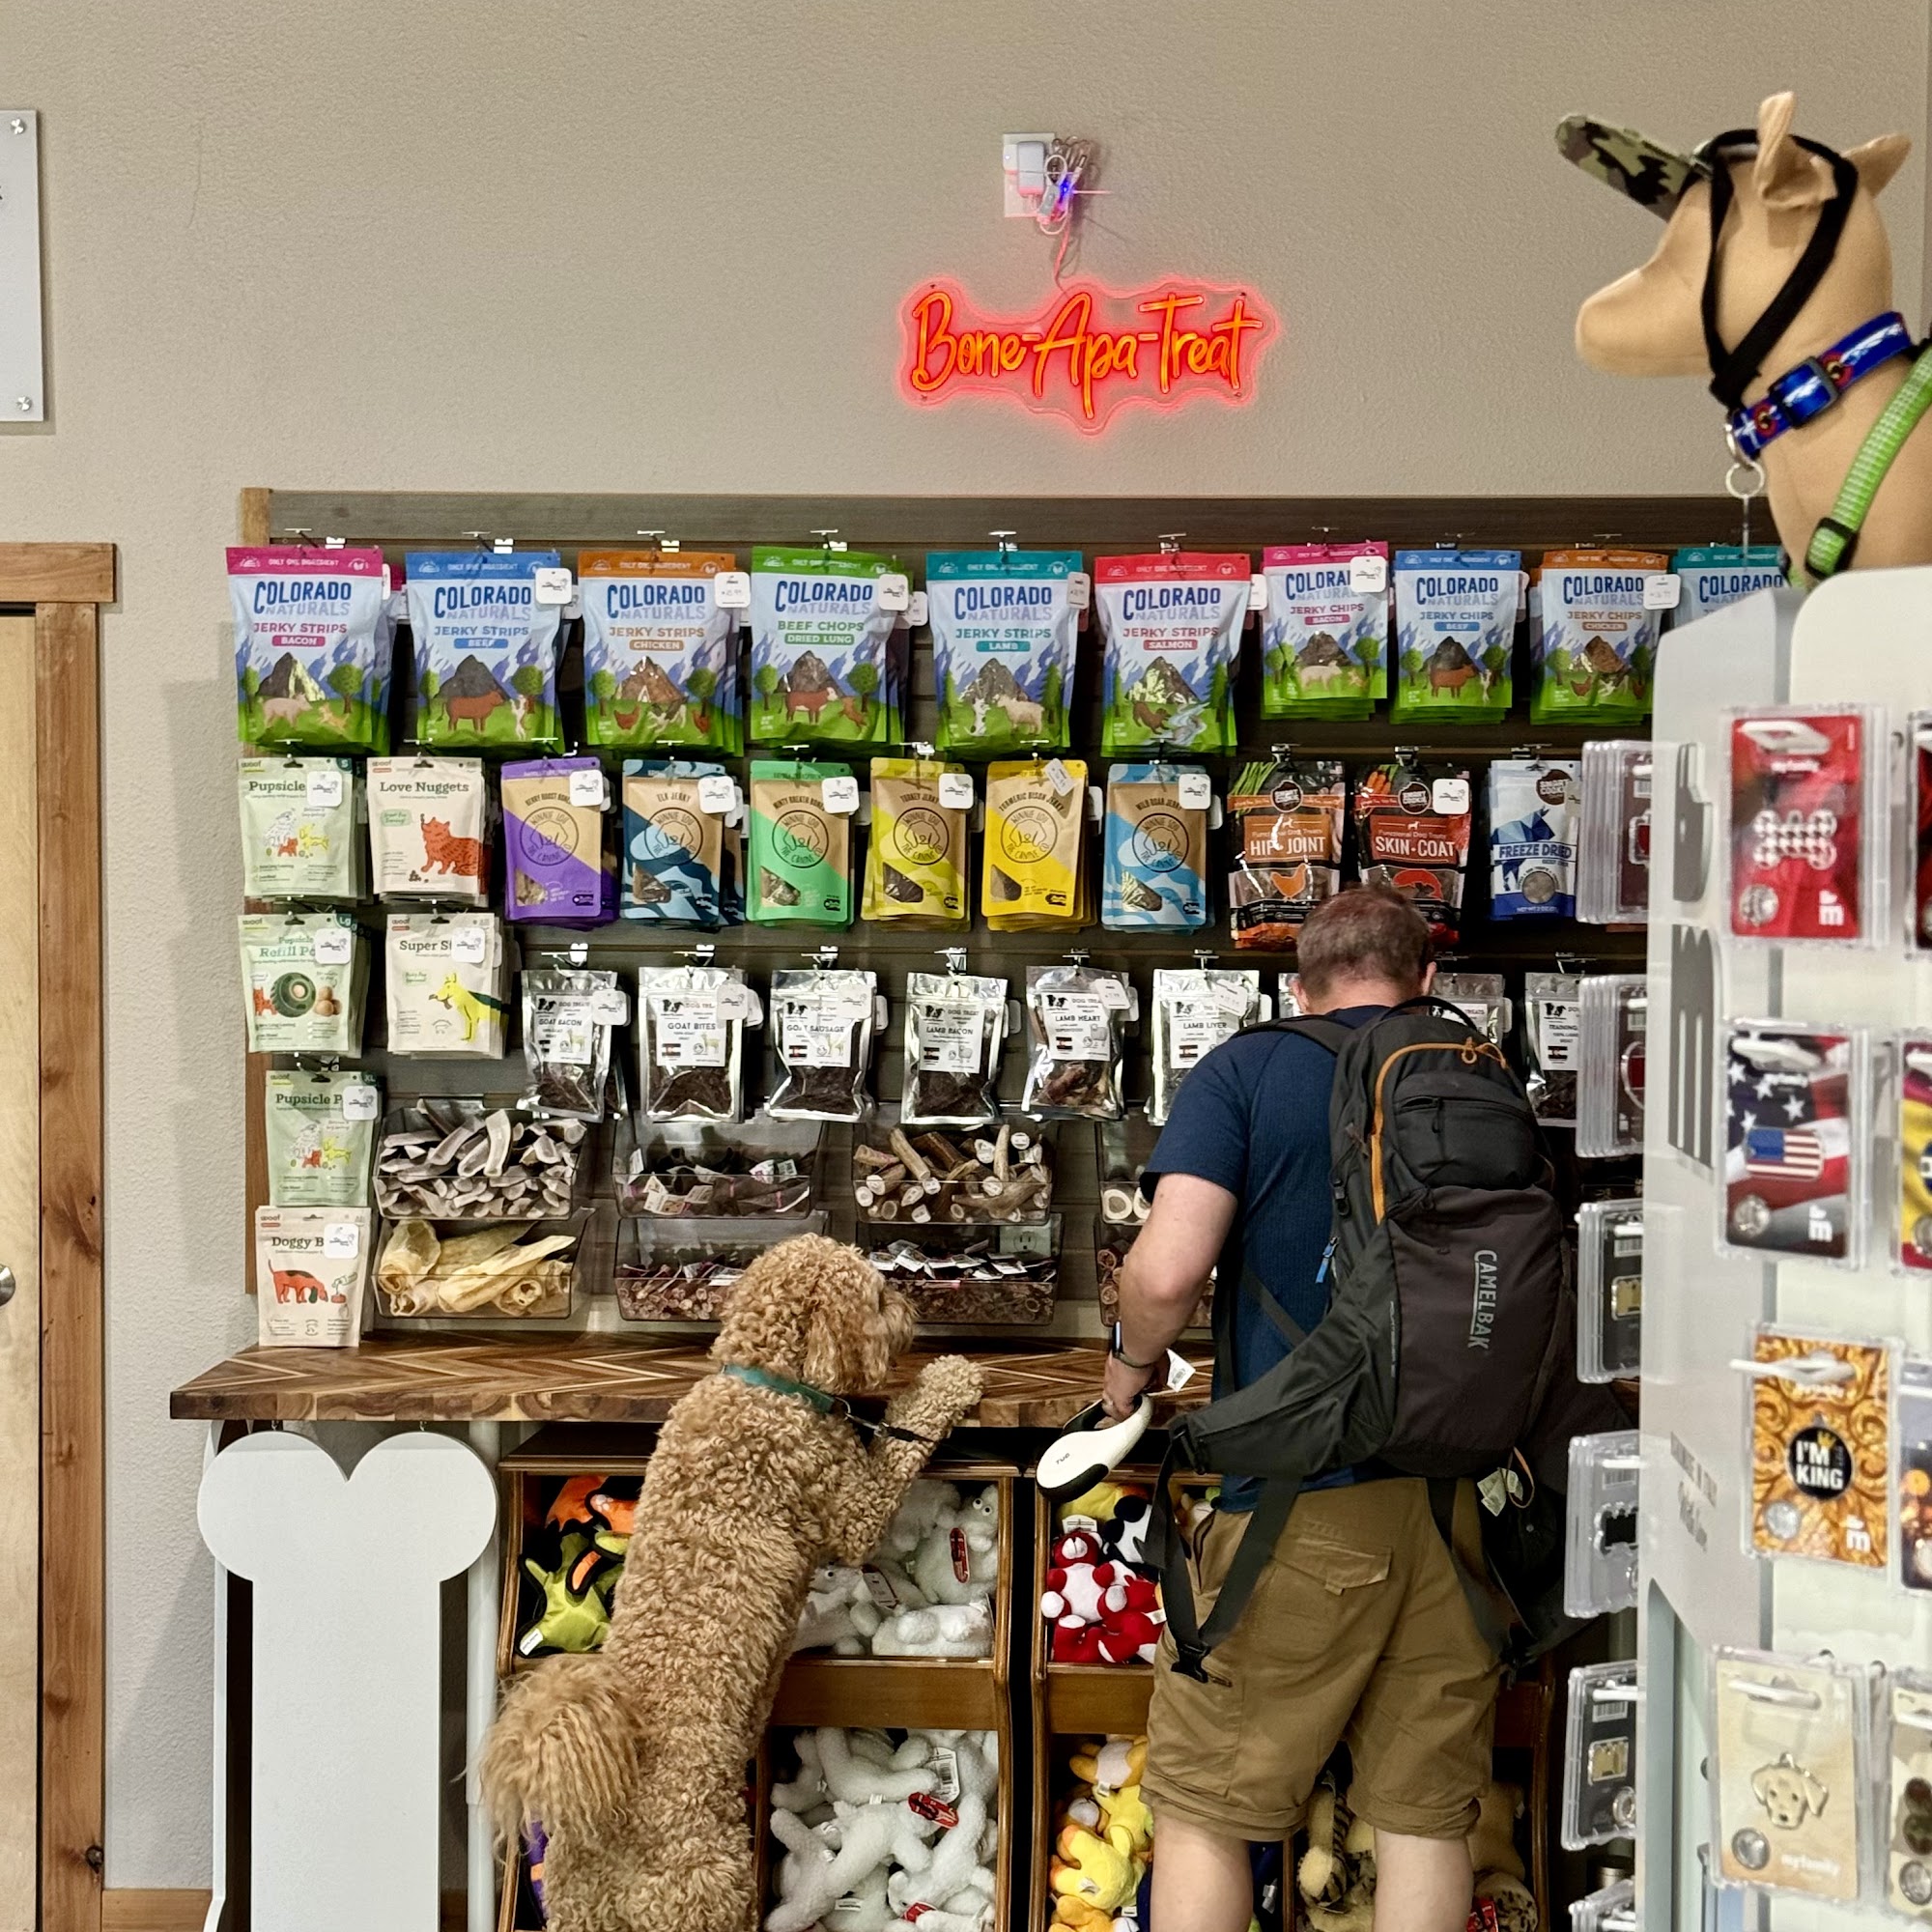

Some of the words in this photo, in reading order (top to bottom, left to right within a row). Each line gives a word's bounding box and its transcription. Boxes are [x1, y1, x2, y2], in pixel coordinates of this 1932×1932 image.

[912, 291, 1264, 419] Bone-Apa-Treat
[1286, 570, 1350, 600] COLORA
[1417, 578, 1498, 605] COLORADO
[1563, 576, 1644, 604] COLORADO
[254, 581, 352, 614] COLORADO
[435, 586, 531, 617] COLORADO
[608, 584, 705, 618] COLORADO
[775, 581, 873, 611] COLORADO
[955, 586, 1052, 620] COLORADO
[1428, 593, 1498, 606] NATURALS
[1574, 593, 1643, 606] NATURALS
[266, 602, 351, 616] NATURALS
[787, 602, 869, 615] NATURALS
[1123, 587, 1221, 620] COLORADO
[1291, 606, 1325, 614] JERKY
[1330, 604, 1364, 612] CHIPS
[446, 606, 531, 621] NATURALS
[620, 606, 705, 620] NATURALS
[968, 607, 1052, 620] NATURALS
[1136, 607, 1221, 620] NATURALS
[1420, 611, 1457, 620] JERKY
[1461, 611, 1493, 620] CHIPS
[253, 623, 297, 633] JERKY
[300, 623, 347, 634] STRIPS
[435, 626, 477, 636] JERKY
[483, 626, 528, 636] STRIPS
[610, 627, 653, 638] JERKY
[657, 628, 704, 638] STRIPS
[778, 620, 812, 630] BEEF
[817, 621, 865, 632] CHOPS
[1123, 628, 1167, 638] JERKY
[1172, 627, 1219, 638] STRIPS
[955, 629, 1000, 639] JERKY
[1004, 629, 1051, 639] STRIPS
[248, 781, 306, 793] Pupsicle
[380, 781, 412, 792] Love
[414, 781, 469, 794] Nuggets
[998, 792, 1027, 811] TURMERIC
[1287, 837, 1326, 854] JOINT
[1376, 836, 1410, 855] SKIN
[1417, 839, 1456, 857] COAT
[1499, 844, 1540, 858] FREEZE
[1542, 844, 1572, 858] DRIED
[260, 947, 296, 957] Refill
[399, 940, 438, 952] Super
[276, 1094, 330, 1106] Pupsicle
[271, 1236, 312, 1249] Doggy
[1468, 1250, 1497, 1350] CAMELBAK
[1796, 1440, 1830, 1466] I'M
[1796, 1464, 1844, 1490] KING
